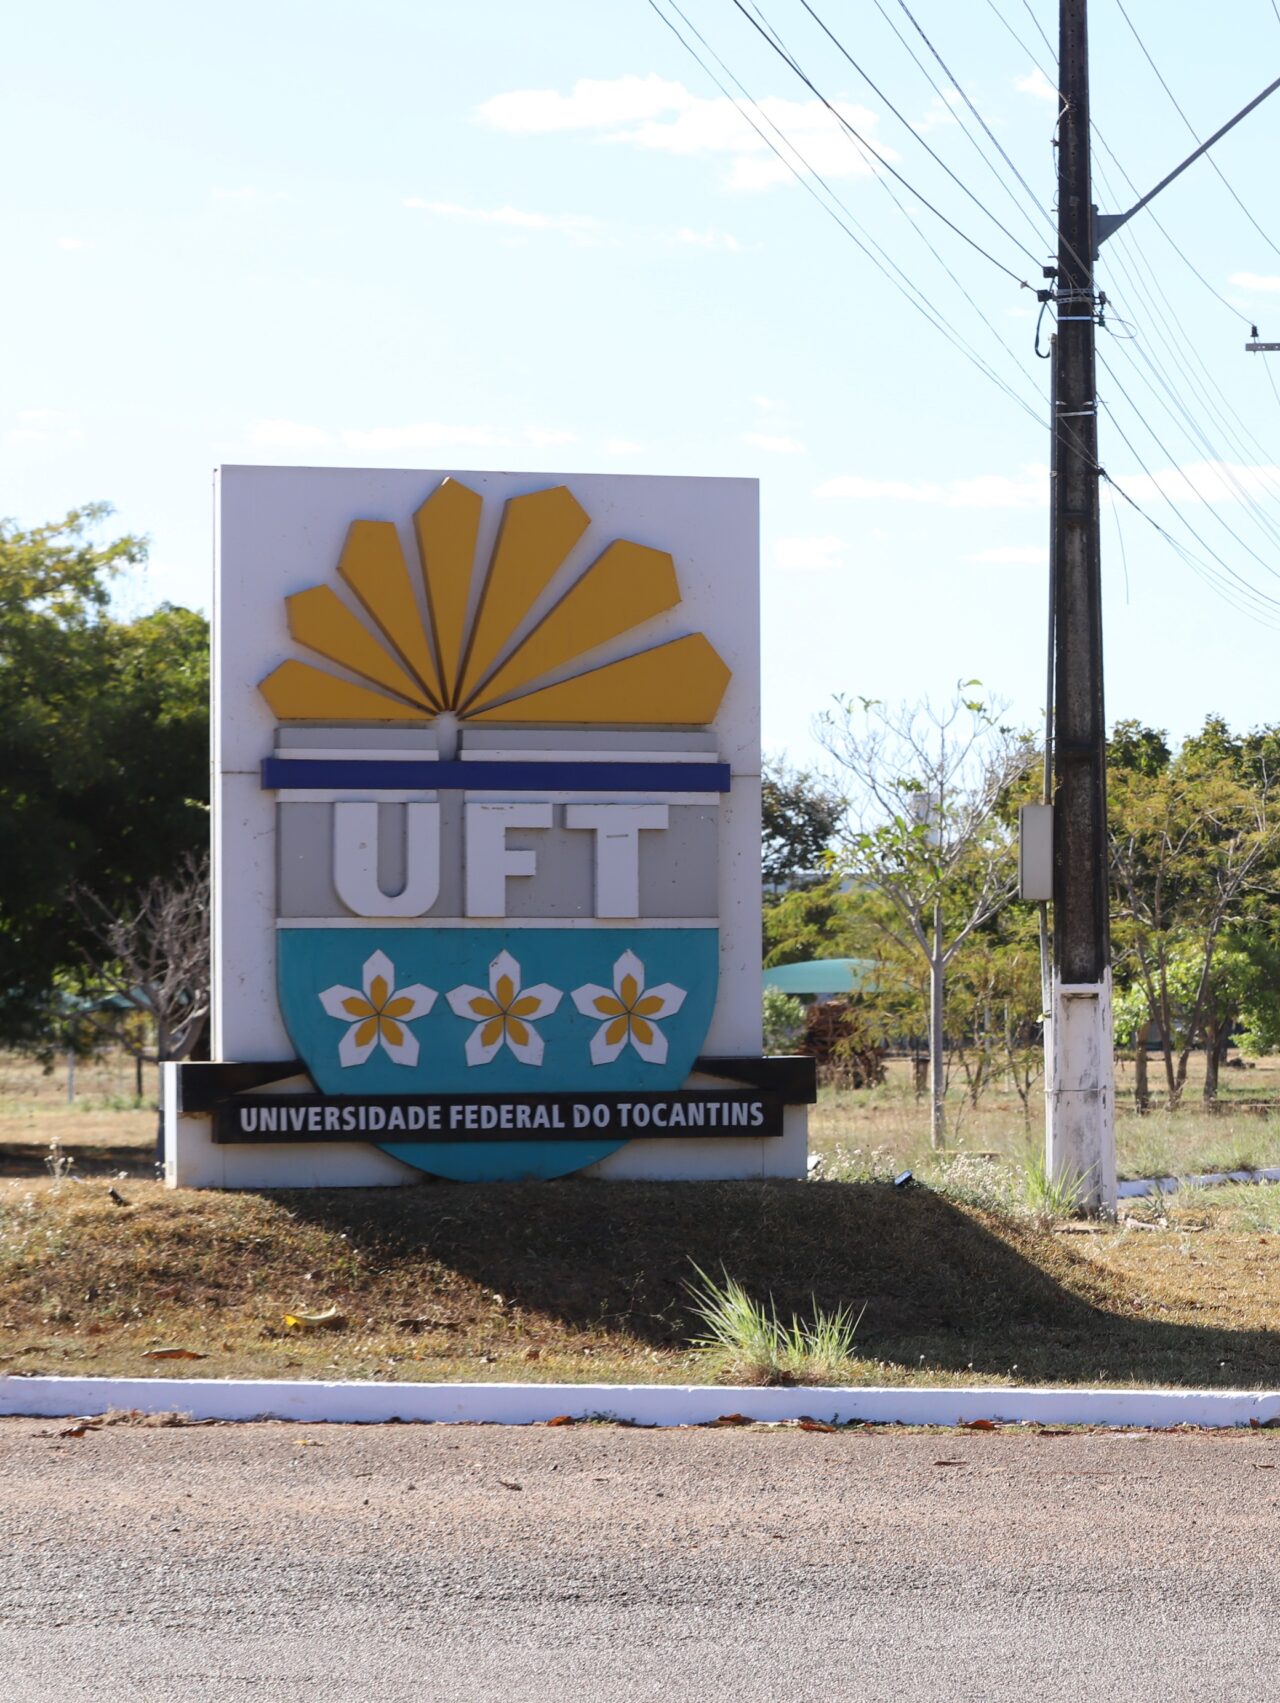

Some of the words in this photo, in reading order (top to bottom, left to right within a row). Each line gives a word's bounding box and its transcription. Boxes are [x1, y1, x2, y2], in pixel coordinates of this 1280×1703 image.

[334, 802, 669, 918] UFT
[240, 1105, 442, 1132] UNIVERSIDADE
[449, 1104, 566, 1130] FEDERAL
[572, 1103, 611, 1128] DO
[616, 1102, 765, 1128] TOCANTINS
